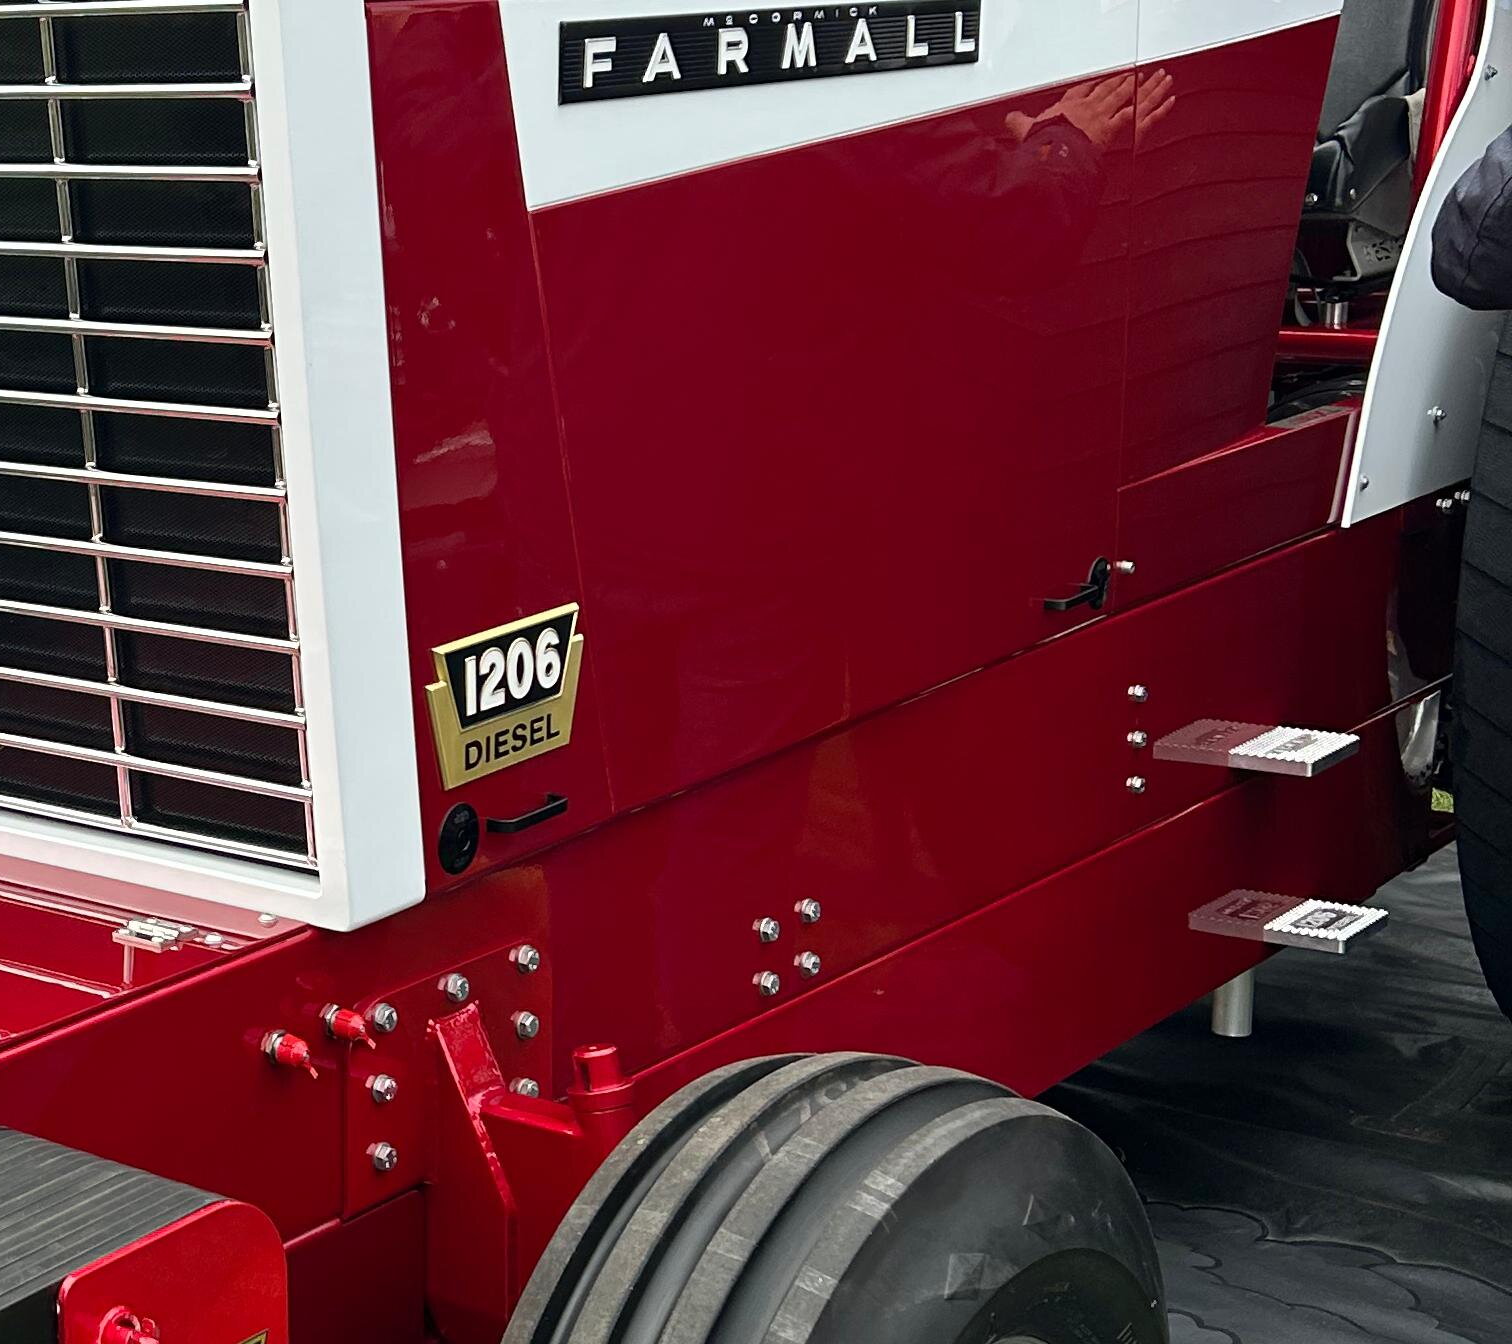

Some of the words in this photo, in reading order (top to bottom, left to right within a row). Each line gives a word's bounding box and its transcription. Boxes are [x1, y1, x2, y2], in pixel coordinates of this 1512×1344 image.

[581, 10, 978, 90] FARMALL
[464, 627, 561, 717] 1206
[464, 713, 561, 772] DIESEL
